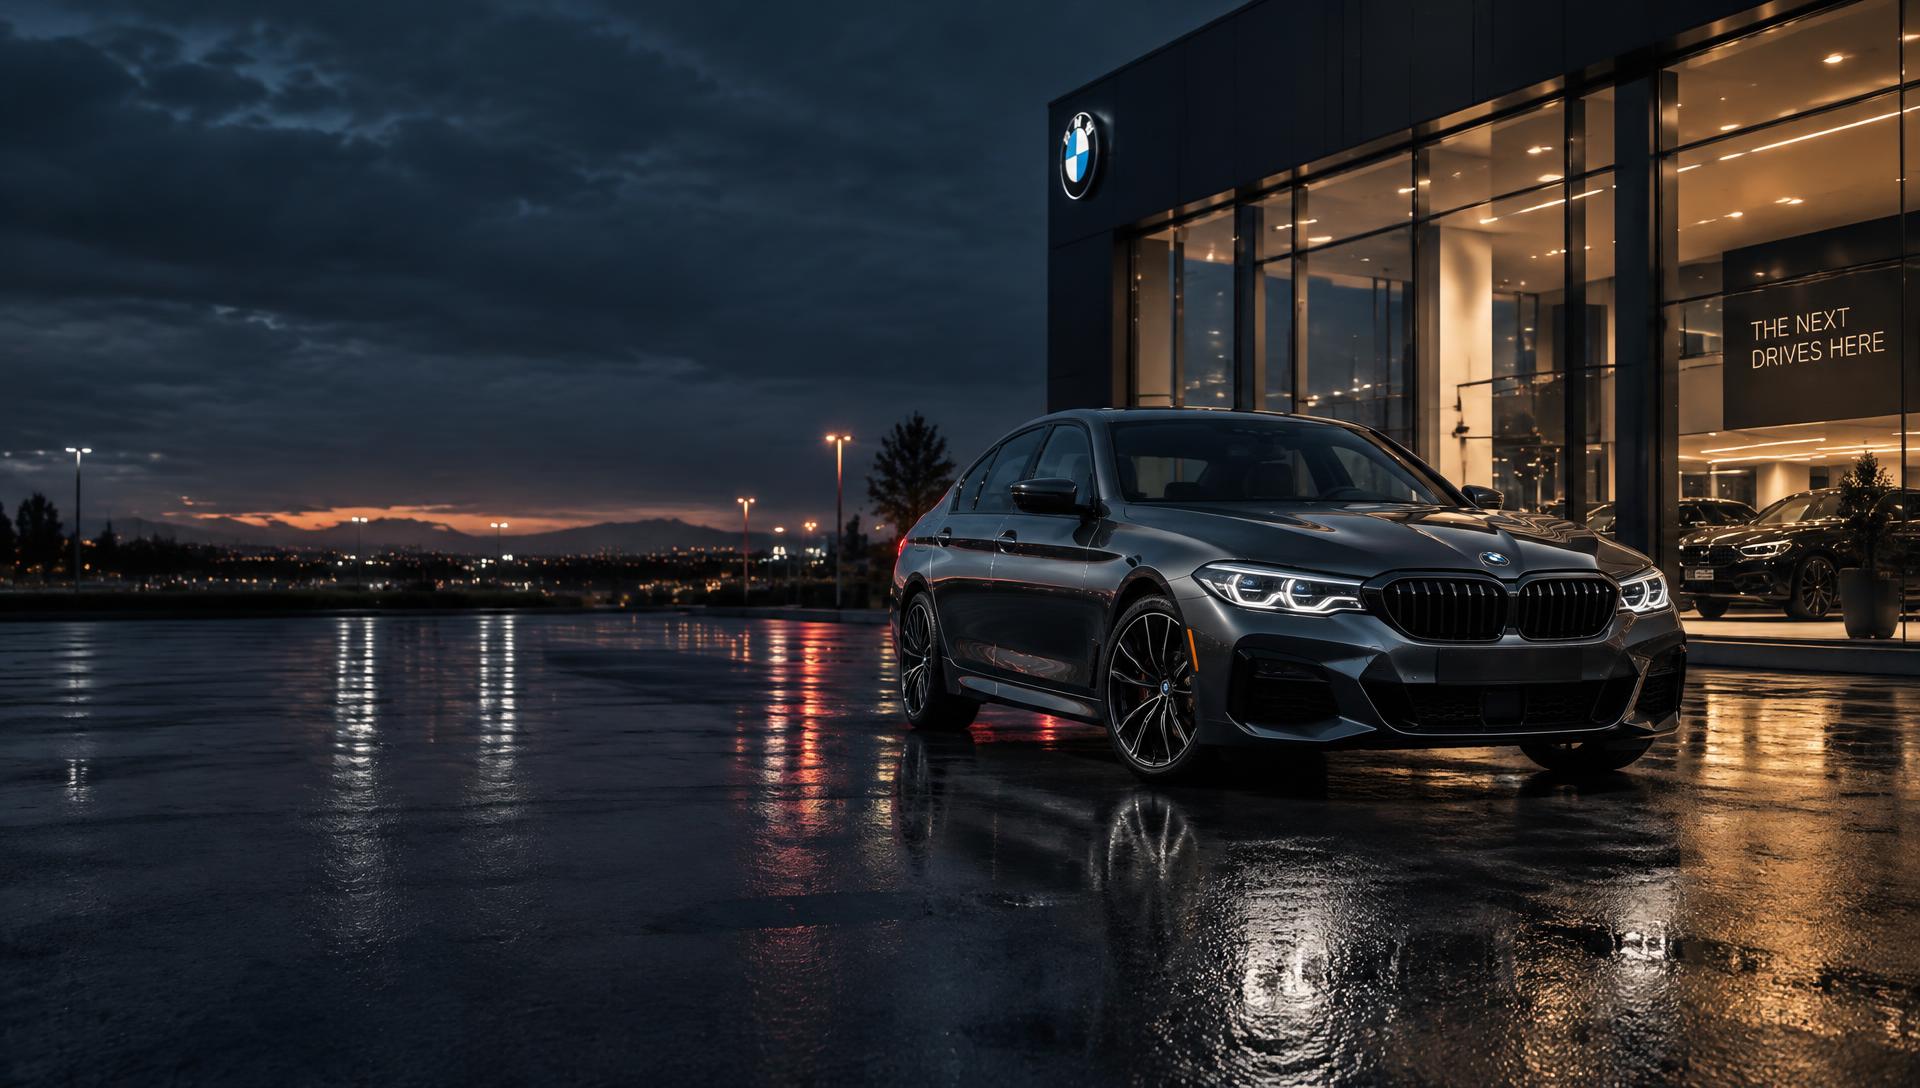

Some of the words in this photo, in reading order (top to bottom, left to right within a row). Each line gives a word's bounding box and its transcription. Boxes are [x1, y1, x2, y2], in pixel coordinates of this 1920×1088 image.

[1751, 317, 1789, 341] THE
[1796, 307, 1850, 334] NEXT
[1752, 340, 1822, 368] DRIVES
[1830, 331, 1886, 359] HERE
